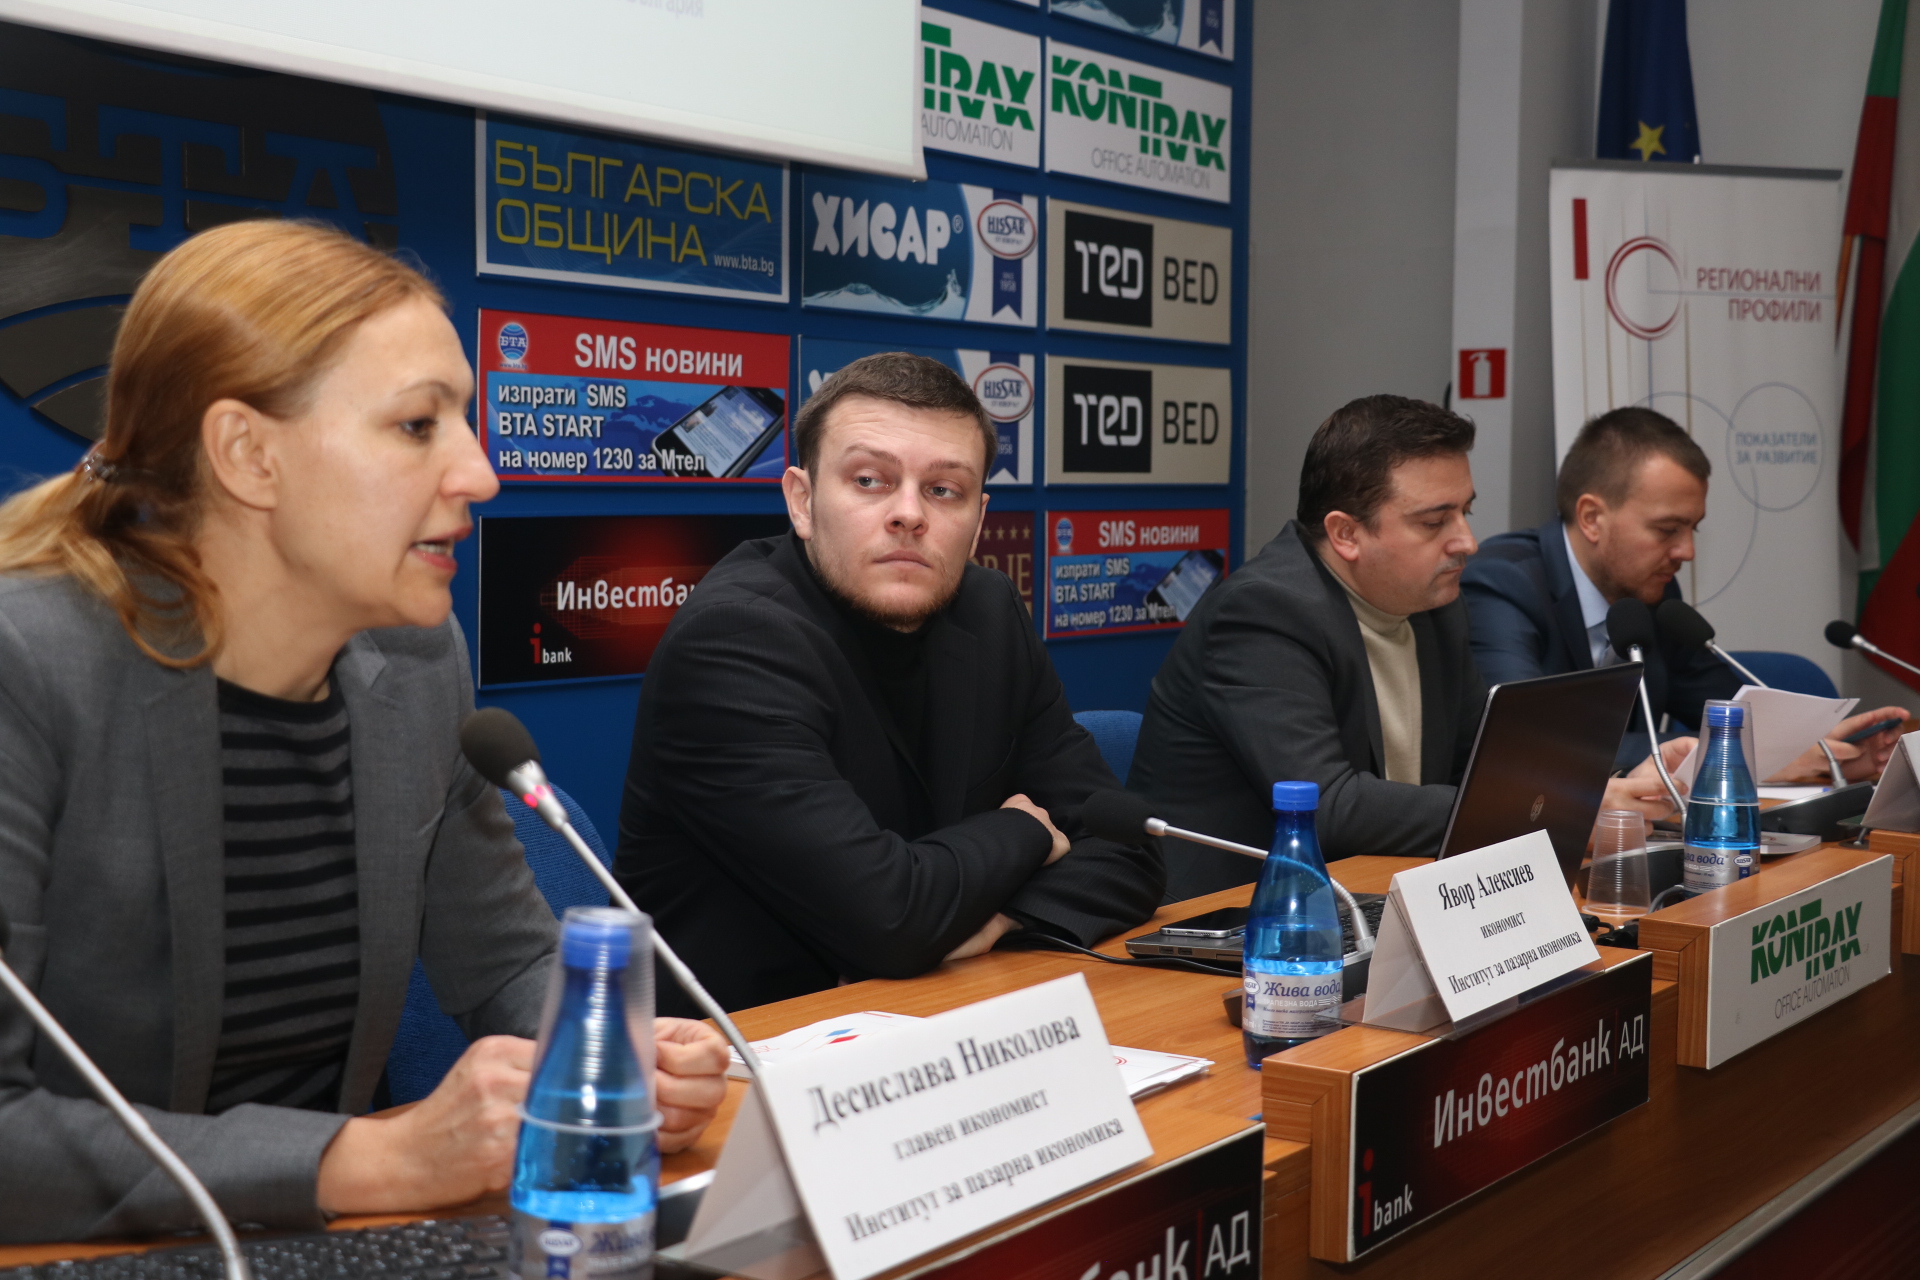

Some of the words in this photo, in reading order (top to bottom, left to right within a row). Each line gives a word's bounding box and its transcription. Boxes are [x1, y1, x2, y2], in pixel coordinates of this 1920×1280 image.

[1052, 54, 1226, 171] KONTRAX
[921, 116, 1014, 152] AUTOMATION
[496, 140, 772, 223] БЪЛГАРСКА
[1091, 147, 1133, 174] OFFICE
[1135, 156, 1210, 189] AUTOMATION
[496, 198, 708, 266] ОБЩИНА
[713, 254, 774, 276] www.bta.bg
[1164, 256, 1219, 306] BED
[1697, 267, 1821, 293] РЕГИОНАЛНИ
[1728, 298, 1821, 322] ПРОФИЛИ
[500, 336, 527, 347] БТА
[575, 333, 637, 371] SMS
[498, 384, 575, 408] изпрати
[587, 384, 626, 408] SMS
[543, 414, 604, 438] START
[1163, 401, 1219, 445] BED
[1736, 431, 1816, 447] ПОКАЗАТЕЛИ
[500, 450, 522, 469] на
[528, 450, 588, 473] номер
[594, 448, 633, 471] 1230
[638, 454, 657, 471] за
[661, 449, 705, 472] Мтел
[1736, 451, 1752, 465] ЗА
[1756, 450, 1817, 465] РАЗВИТИЕ
[1099, 520, 1136, 547] SMS
[1055, 563, 1100, 581] изпрати
[1105, 558, 1130, 576] SMS
[1080, 582, 1116, 601] START
[1055, 612, 1069, 627] на
[1070, 610, 1106, 628] номер
[1109, 605, 1133, 622] 1230
[1135, 608, 1147, 621] за
[1438, 882, 1475, 910] Явор
[1476, 863, 1534, 898] Алексиев
[1480, 911, 1526, 939] икономист
[1751, 898, 1862, 985] KONTRAX
[1447, 965, 1495, 995] Институт
[1496, 961, 1505, 977] за
[1504, 948, 1538, 970] пазарна
[1537, 931, 1582, 958] икономика
[1263, 981, 1310, 997] Жива
[1314, 979, 1341, 997] вода
[1774, 987, 1802, 1019] OFFICE
[1803, 966, 1850, 1003] AUTOMATION
[806, 1055, 956, 1136] Десислава
[957, 1015, 1080, 1075] Николова
[1433, 1018, 1611, 1148] Инвестбанк
[1619, 1014, 1644, 1059] АД
[892, 1122, 956, 1161] главен
[959, 1088, 1050, 1136] икономист
[843, 1191, 940, 1242] Институт
[944, 1179, 964, 1203] за
[966, 1153, 1035, 1195] пазарна
[1036, 1117, 1124, 1165] икономика
[1204, 1210, 1250, 1277] АД
